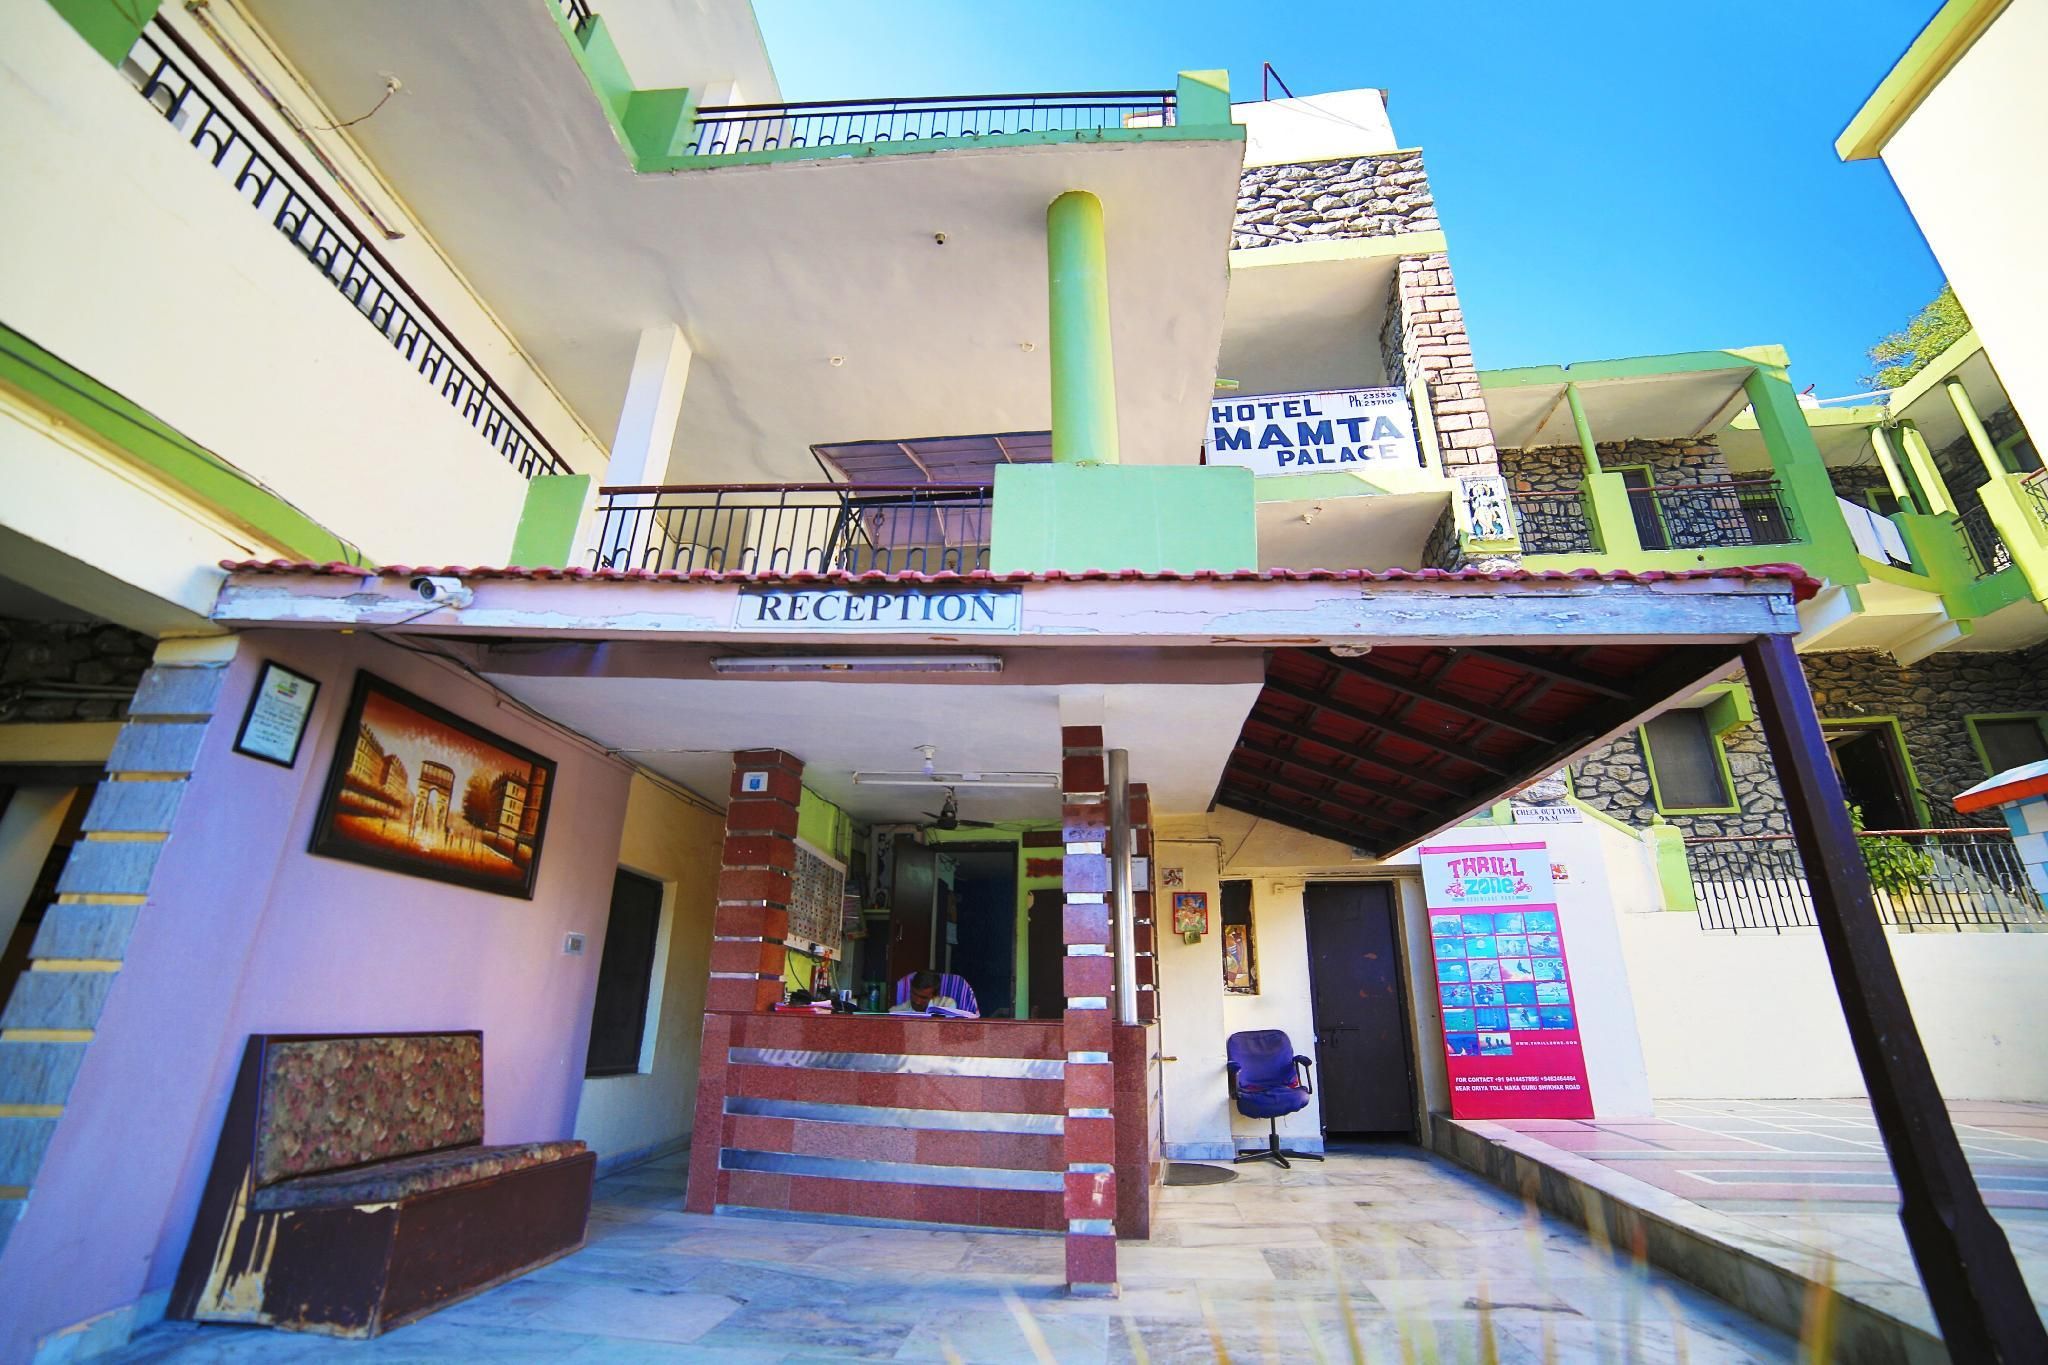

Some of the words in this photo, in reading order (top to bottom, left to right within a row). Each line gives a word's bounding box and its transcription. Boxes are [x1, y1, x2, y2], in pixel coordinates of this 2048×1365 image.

[1212, 399, 1323, 423] HOTEL
[1214, 416, 1405, 451] MAMTA
[1277, 443, 1400, 467] PALACE
[757, 593, 998, 622] RECEPTION
[1558, 807, 1577, 815] TIME
[1447, 856, 1525, 878] THRILL
